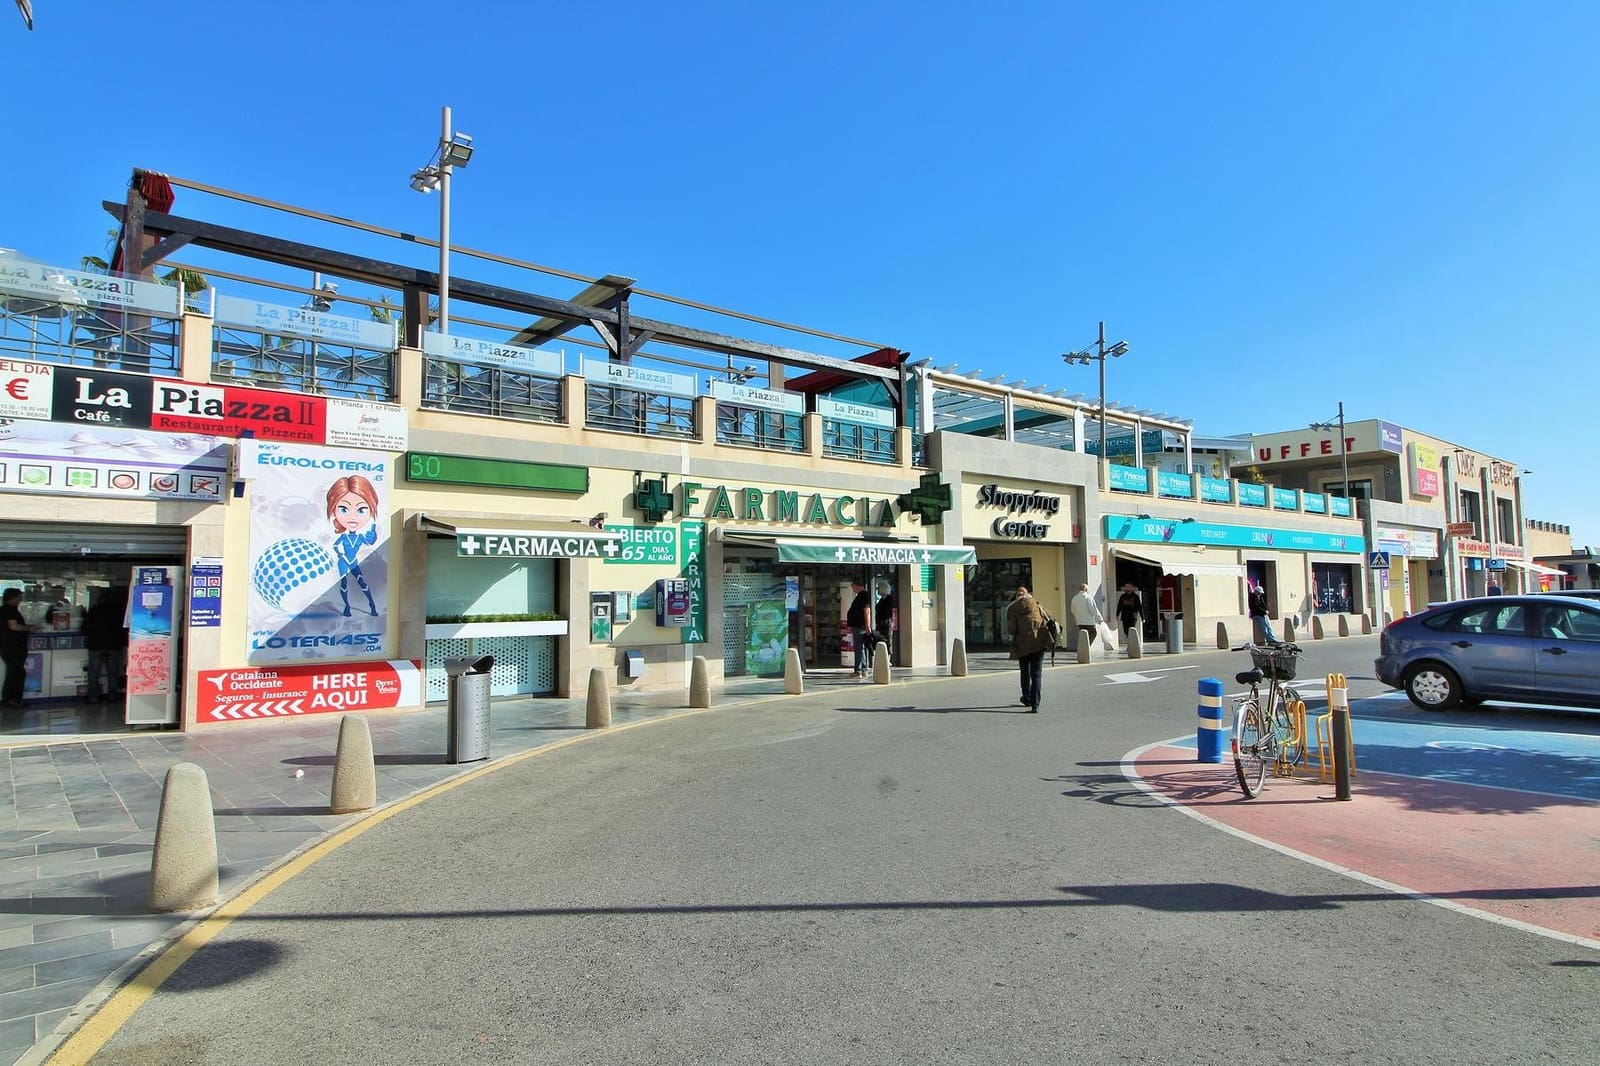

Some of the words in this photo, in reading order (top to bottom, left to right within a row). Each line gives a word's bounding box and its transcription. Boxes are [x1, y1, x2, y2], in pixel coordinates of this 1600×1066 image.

[0, 264, 30, 280] La
[41, 267, 121, 294] Piazza
[256, 304, 280, 319] La
[288, 309, 348, 330] Piazza
[453, 338, 472, 351] La
[479, 342, 526, 360] Piazza
[24, 364, 50, 375] DIA
[608, 365, 622, 377] La
[627, 368, 665, 384] Piazza
[5, 377, 30, 400] €
[75, 377, 131, 408] La
[732, 386, 744, 396] La
[748, 389, 779, 402] Piazza
[74, 409, 110, 422] Café
[159, 387, 294, 423] Piazza
[298, 401, 315, 425] II
[834, 403, 844, 412] La
[848, 405, 874, 418] Piazza
[262, 426, 314, 440] Pizzeria
[684, 482, 896, 527] FARMACIA
[980, 484, 1061, 514] Shopping
[610, 528, 673, 543] BIERTO
[993, 516, 1051, 538] Center
[485, 536, 599, 556] FARMACIA
[652, 546, 669, 554] DIAS
[851, 548, 917, 563] FARMACIA
[658, 553, 674, 561] AÑO
[688, 538, 701, 641] FARMACIA
[252, 633, 383, 649] LOTERIASS
[231, 671, 278, 681] Catalana
[312, 673, 367, 690] HERE
[231, 679, 283, 690] Occidente
[215, 694, 254, 704] Seguros
[263, 690, 308, 699] Insurance
[311, 690, 368, 709] AQUI
